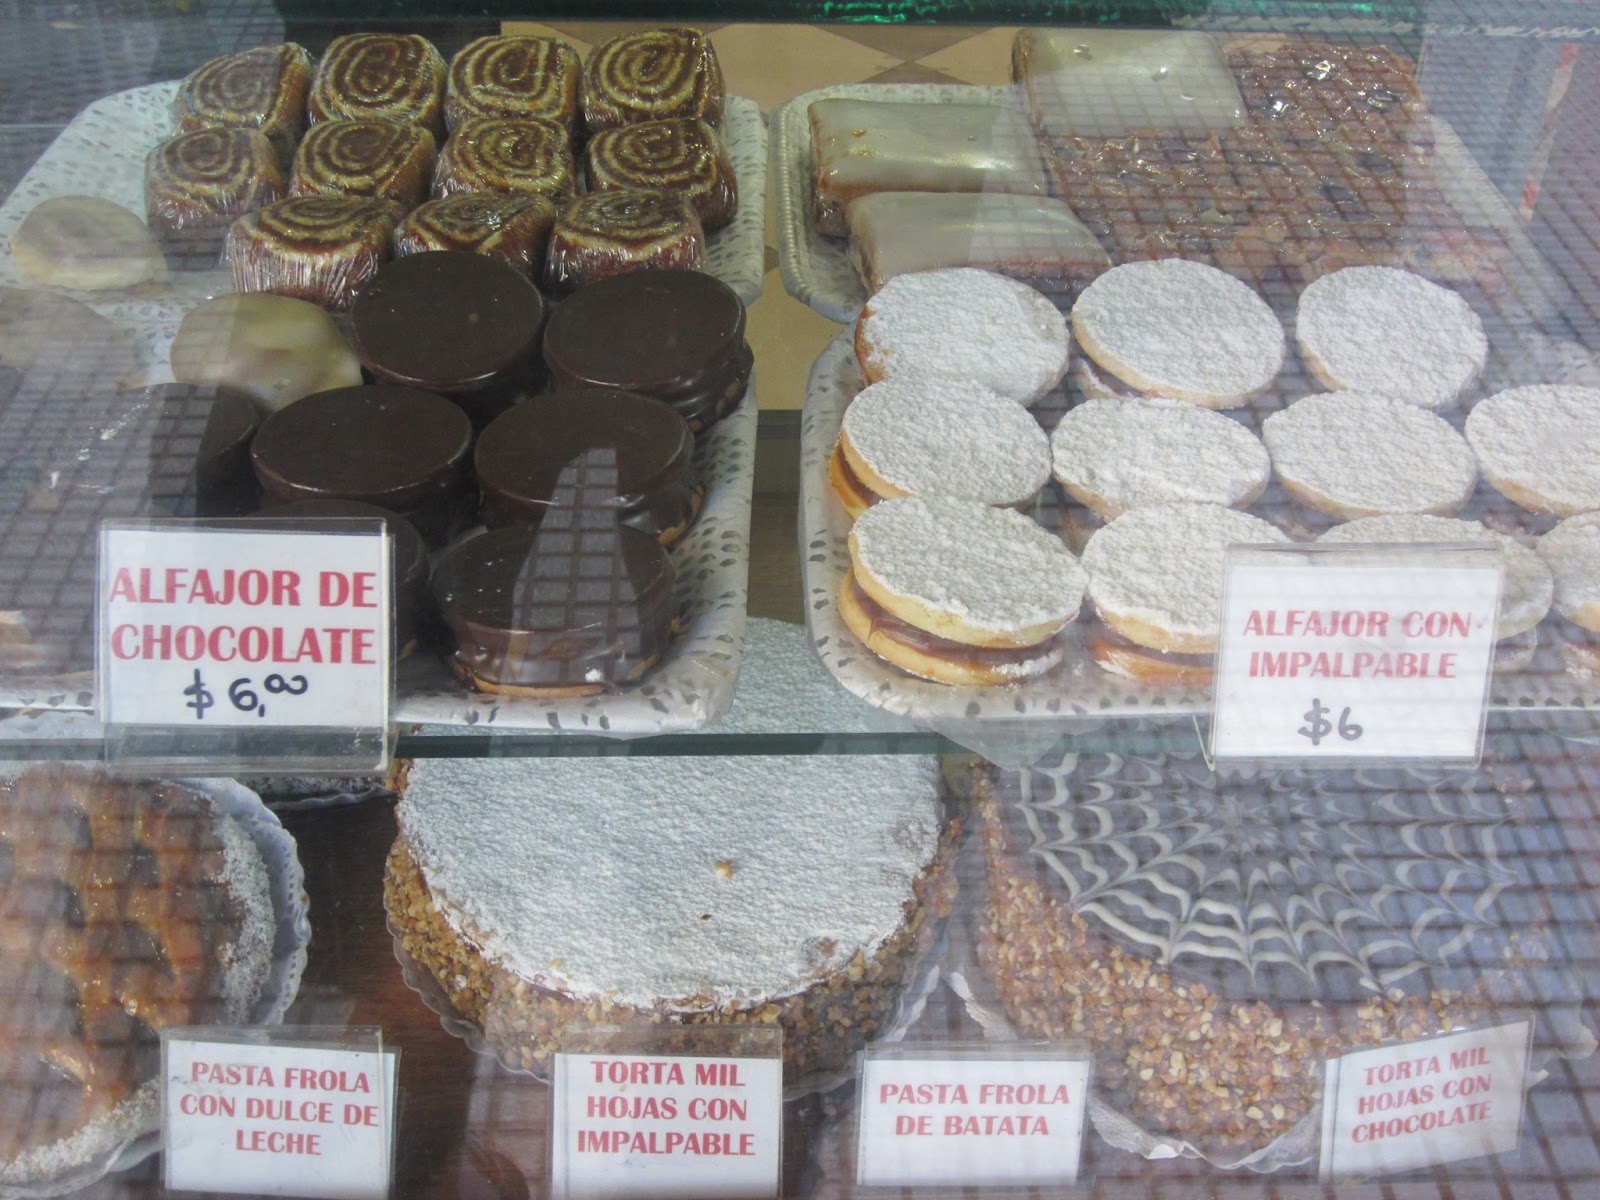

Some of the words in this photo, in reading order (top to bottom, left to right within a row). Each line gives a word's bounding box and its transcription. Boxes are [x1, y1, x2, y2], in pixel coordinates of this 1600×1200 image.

[109, 568, 300, 606] ALFAJOR
[319, 571, 377, 607] DE
[1243, 610, 1389, 637] ALFAJOR
[1402, 611, 1471, 638] CON
[111, 624, 376, 664] CHOCOLATE
[1249, 652, 1457, 678] IMPALPABLE
[1297, 698, 1363, 746] $6
[191, 1061, 274, 1087] PASTA
[284, 1068, 370, 1093] FROLA
[591, 1061, 685, 1085] TORTA
[695, 1064, 746, 1087] MIL
[1363, 1056, 1441, 1086] TORTA
[1449, 1047, 1491, 1070] MIL
[587, 1096, 678, 1119] HOJAS
[688, 1098, 747, 1121] CON
[880, 1084, 968, 1104] PASTA
[979, 1084, 1070, 1104] FROLA
[1358, 1085, 1434, 1115] HOJAS
[1442, 1074, 1492, 1099] CON
[180, 1094, 235, 1117] CON
[246, 1098, 333, 1123] DULCE
[344, 1104, 379, 1126] DE
[1351, 1101, 1494, 1143] CHOCOLATE
[895, 1115, 933, 1136] DE
[944, 1115, 1049, 1136] BATATA
[236, 1130, 321, 1155] LECHE
[577, 1130, 756, 1156] IMPALPABLE
